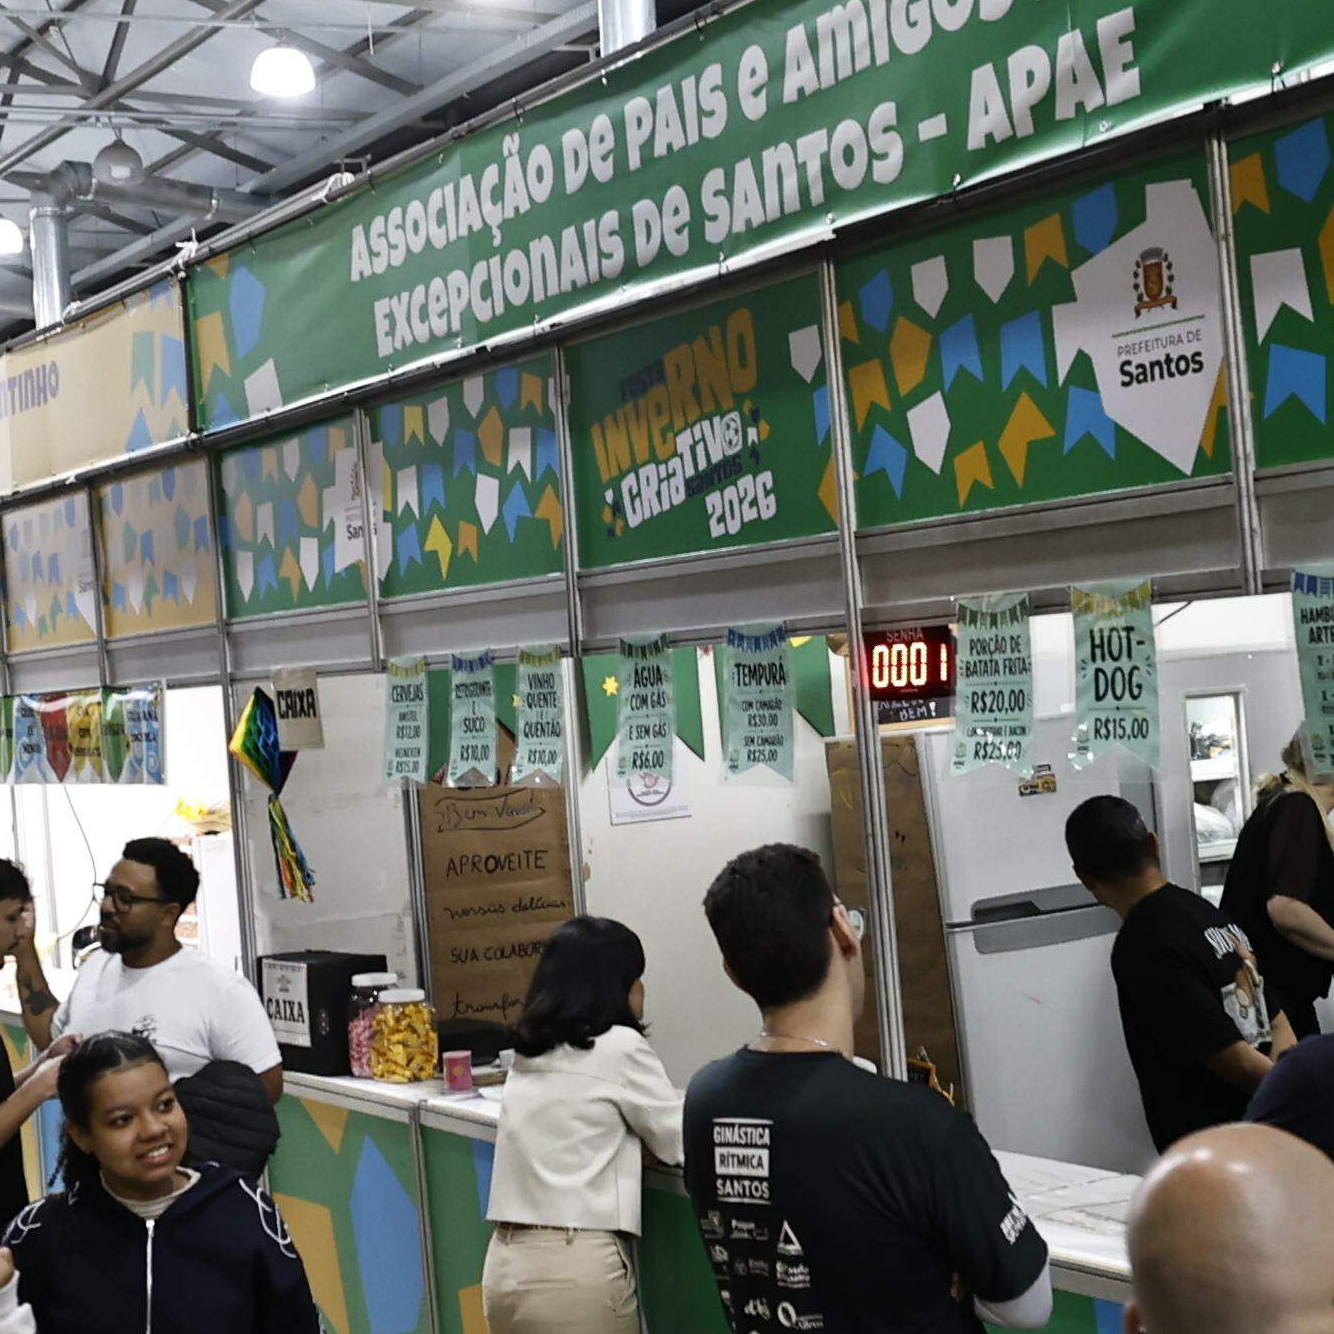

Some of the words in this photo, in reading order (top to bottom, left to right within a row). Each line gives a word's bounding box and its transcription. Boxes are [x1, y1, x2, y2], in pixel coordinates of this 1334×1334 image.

[701, 101, 905, 244] SANTOS
[966, 6, 1141, 151] APAE
[350, 132, 553, 281] ASSOCIAÇÃO
[624, 62, 728, 171] PAIS
[1117, 333, 1185, 357] PREFEITURA
[1186, 329, 1202, 343] DE
[1119, 351, 1204, 387] Santos
[886, 627, 923, 643] SENHA
[969, 634, 1006, 658] PORÇÃO
[1010, 634, 1021, 653] DE
[1090, 625, 1146, 663] HOT-
[633, 662, 663, 689] ÁGUA
[734, 656, 787, 688] TEMPURÁ
[966, 659, 1000, 678] BATATA
[1003, 657, 1028, 675] FRITA
[392, 683, 424, 703] CERVEJAS
[527, 673, 555, 691] VINHO
[1094, 666, 1143, 702] DOG
[276, 687, 317, 719] CAIXA
[526, 691, 557, 709] QUENTE
[630, 694, 649, 711] COM
[651, 691, 666, 709] GÁS
[971, 689, 1025, 715] R$20,00
[463, 717, 485, 733] SUCO
[523, 718, 561, 739] QUENTÃO
[629, 728, 633, 741] E
[636, 725, 651, 739] SEM
[653, 722, 667, 738] GÁS
[1094, 717, 1149, 741] R$15,00
[744, 736, 756, 747] SEM
[631, 750, 664, 770] R$6,00
[446, 849, 548, 878] APROVEITE
[450, 946, 479, 964] SUA
[484, 940, 545, 962] COLABOR
[267, 997, 305, 1024] CAIXA
[713, 1124, 770, 1146] GINÁSTICA
[719, 1152, 764, 1171] RÍTMICA
[717, 1179, 770, 1199] SANTOS
